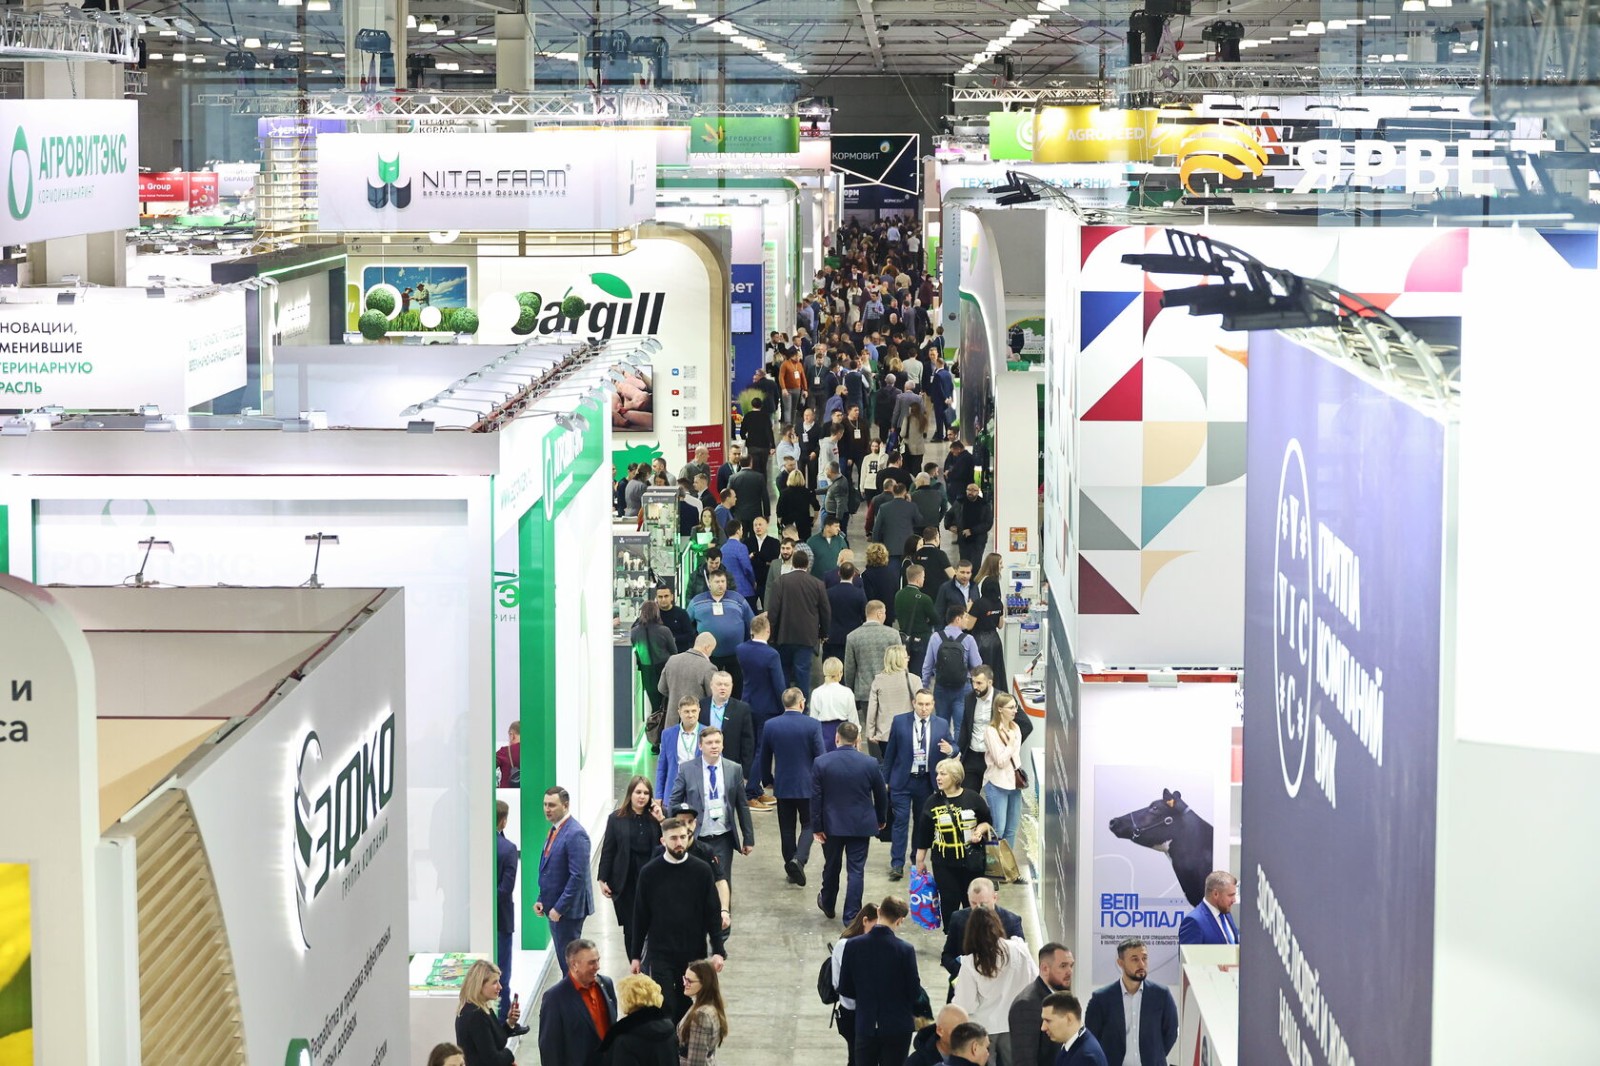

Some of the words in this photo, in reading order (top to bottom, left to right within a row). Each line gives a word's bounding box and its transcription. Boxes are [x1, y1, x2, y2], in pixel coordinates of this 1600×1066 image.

[38, 133, 127, 180] АГРОВИТЭКС
[832, 152, 880, 160] КОРМОВИТ
[1067, 128, 1144, 141] AGROFEED
[1293, 139, 1556, 195] ЯРВЕТ
[0, 361, 93, 374] ЕРИНАРНУЮ
[1317, 521, 1360, 632] ГРУППА
[1316, 616, 1384, 767] КОМПАНИЙ
[1315, 714, 1337, 809] ВИК
[313, 712, 395, 898] ЭФКО
